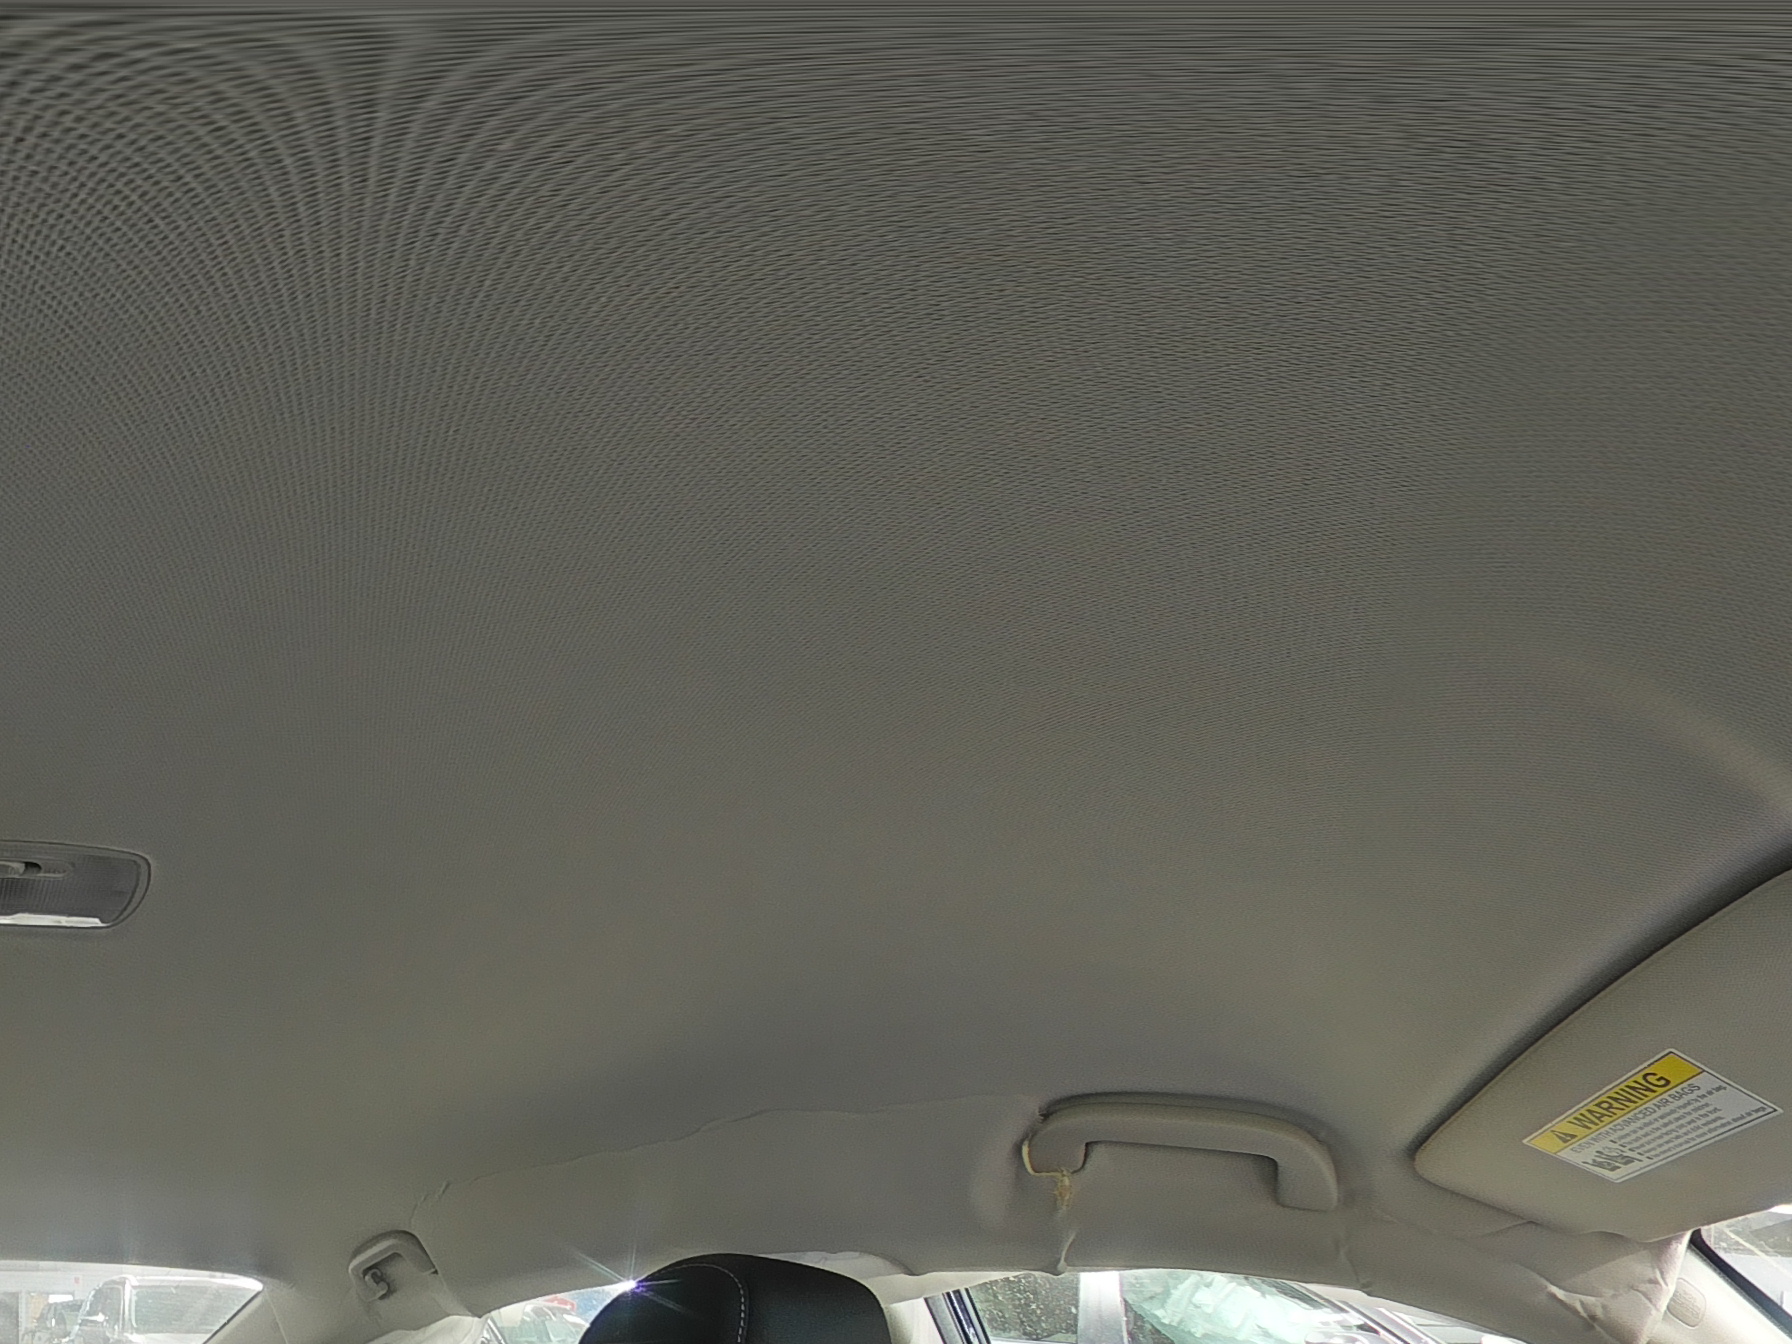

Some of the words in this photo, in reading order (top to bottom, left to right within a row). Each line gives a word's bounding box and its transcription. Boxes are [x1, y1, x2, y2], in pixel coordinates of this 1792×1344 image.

[1567, 1071, 1673, 1131] WARNING
[1569, 1140, 1595, 1153] EVEN
[1588, 1129, 1614, 1143] WITH
[1609, 1105, 1656, 1133] ADVANCED
[1654, 1096, 1675, 1110] AIR
[1673, 1083, 1701, 1101] BAGS
